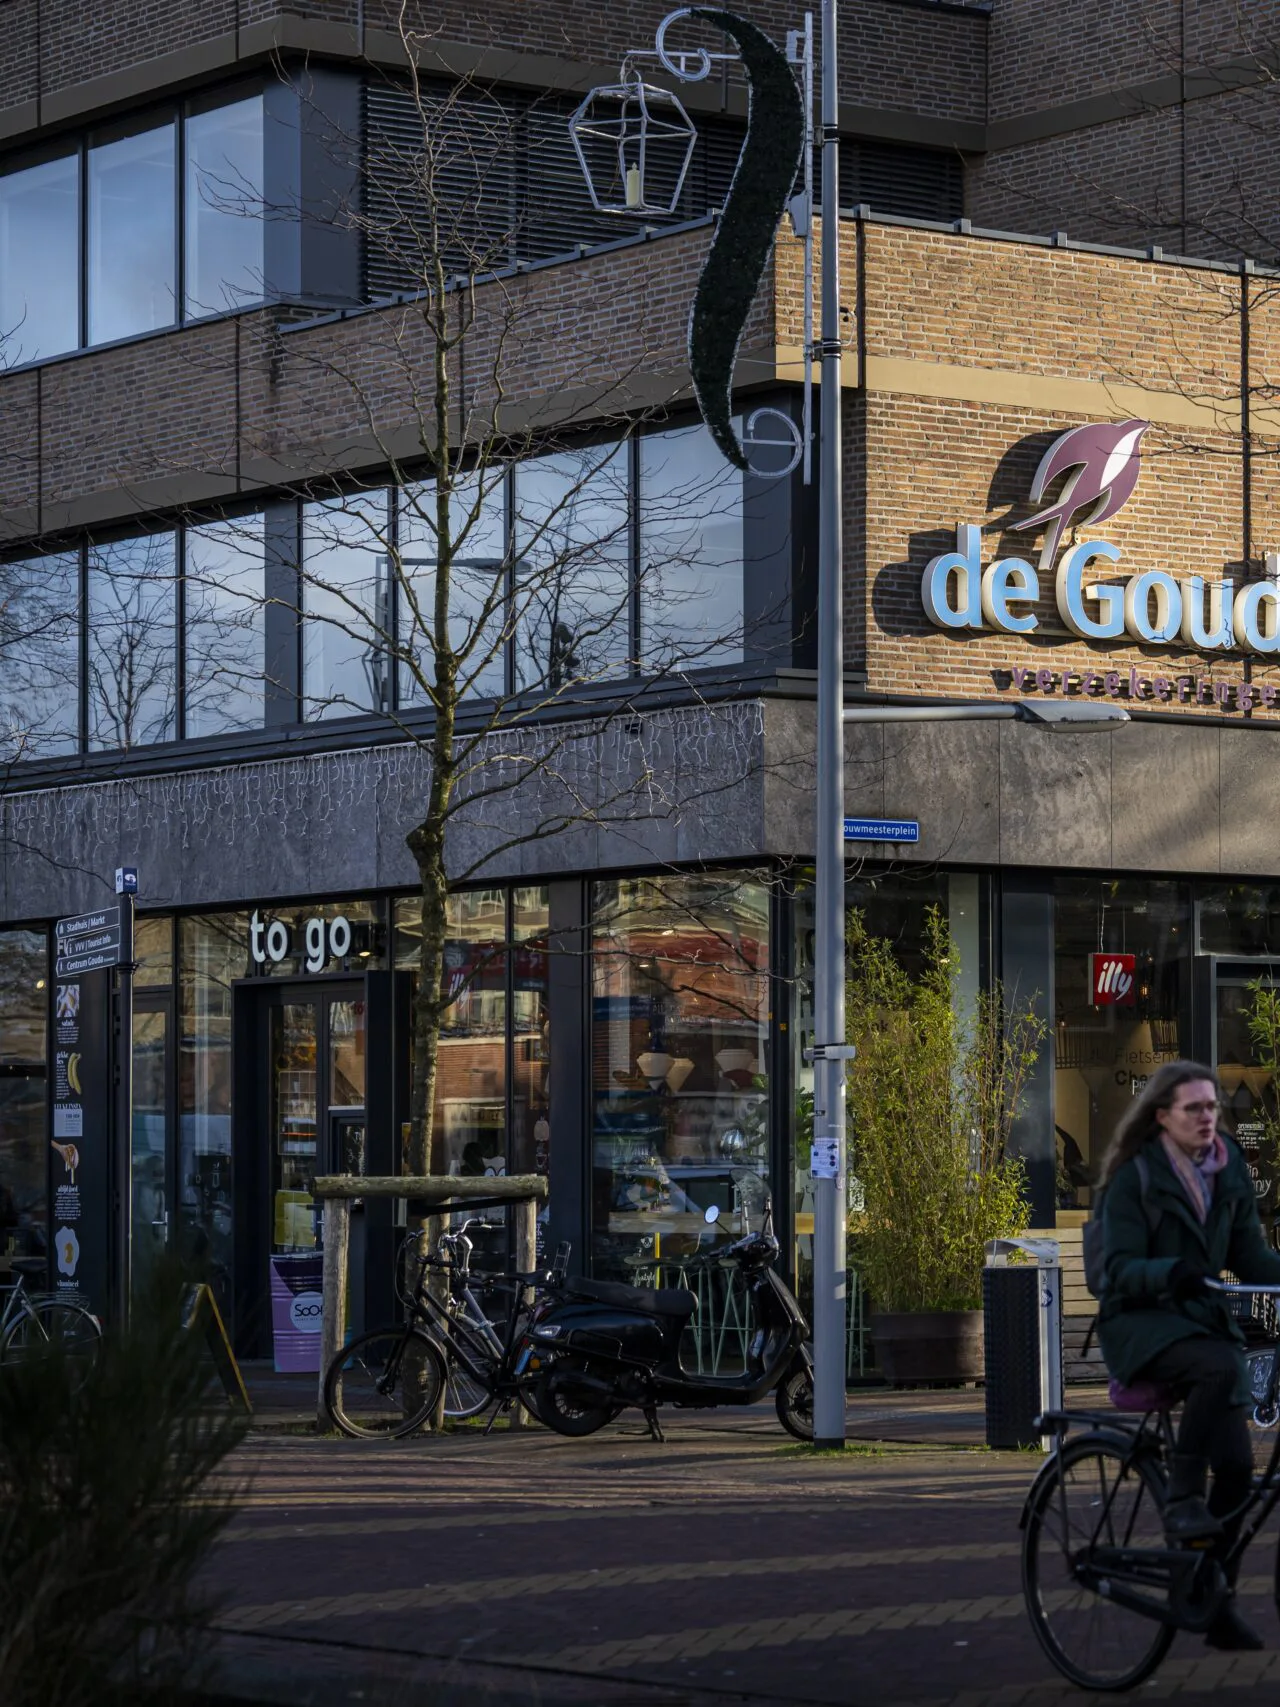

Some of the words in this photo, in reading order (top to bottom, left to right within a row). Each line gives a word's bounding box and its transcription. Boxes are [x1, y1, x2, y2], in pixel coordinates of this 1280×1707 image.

[922, 523, 1040, 633] de
[844, 825, 916, 837] ouwmeesterplein
[67, 921, 87, 931] Stadhuis
[91, 916, 105, 927] Markt
[75, 941, 85, 952] VVV
[88, 937, 102, 948] Tourist
[250, 909, 288, 963] to
[306, 916, 351, 972] go
[67, 960, 87, 970] Centrum
[88, 955, 104, 966] Gouda
[1097, 961, 1133, 1001] illy
